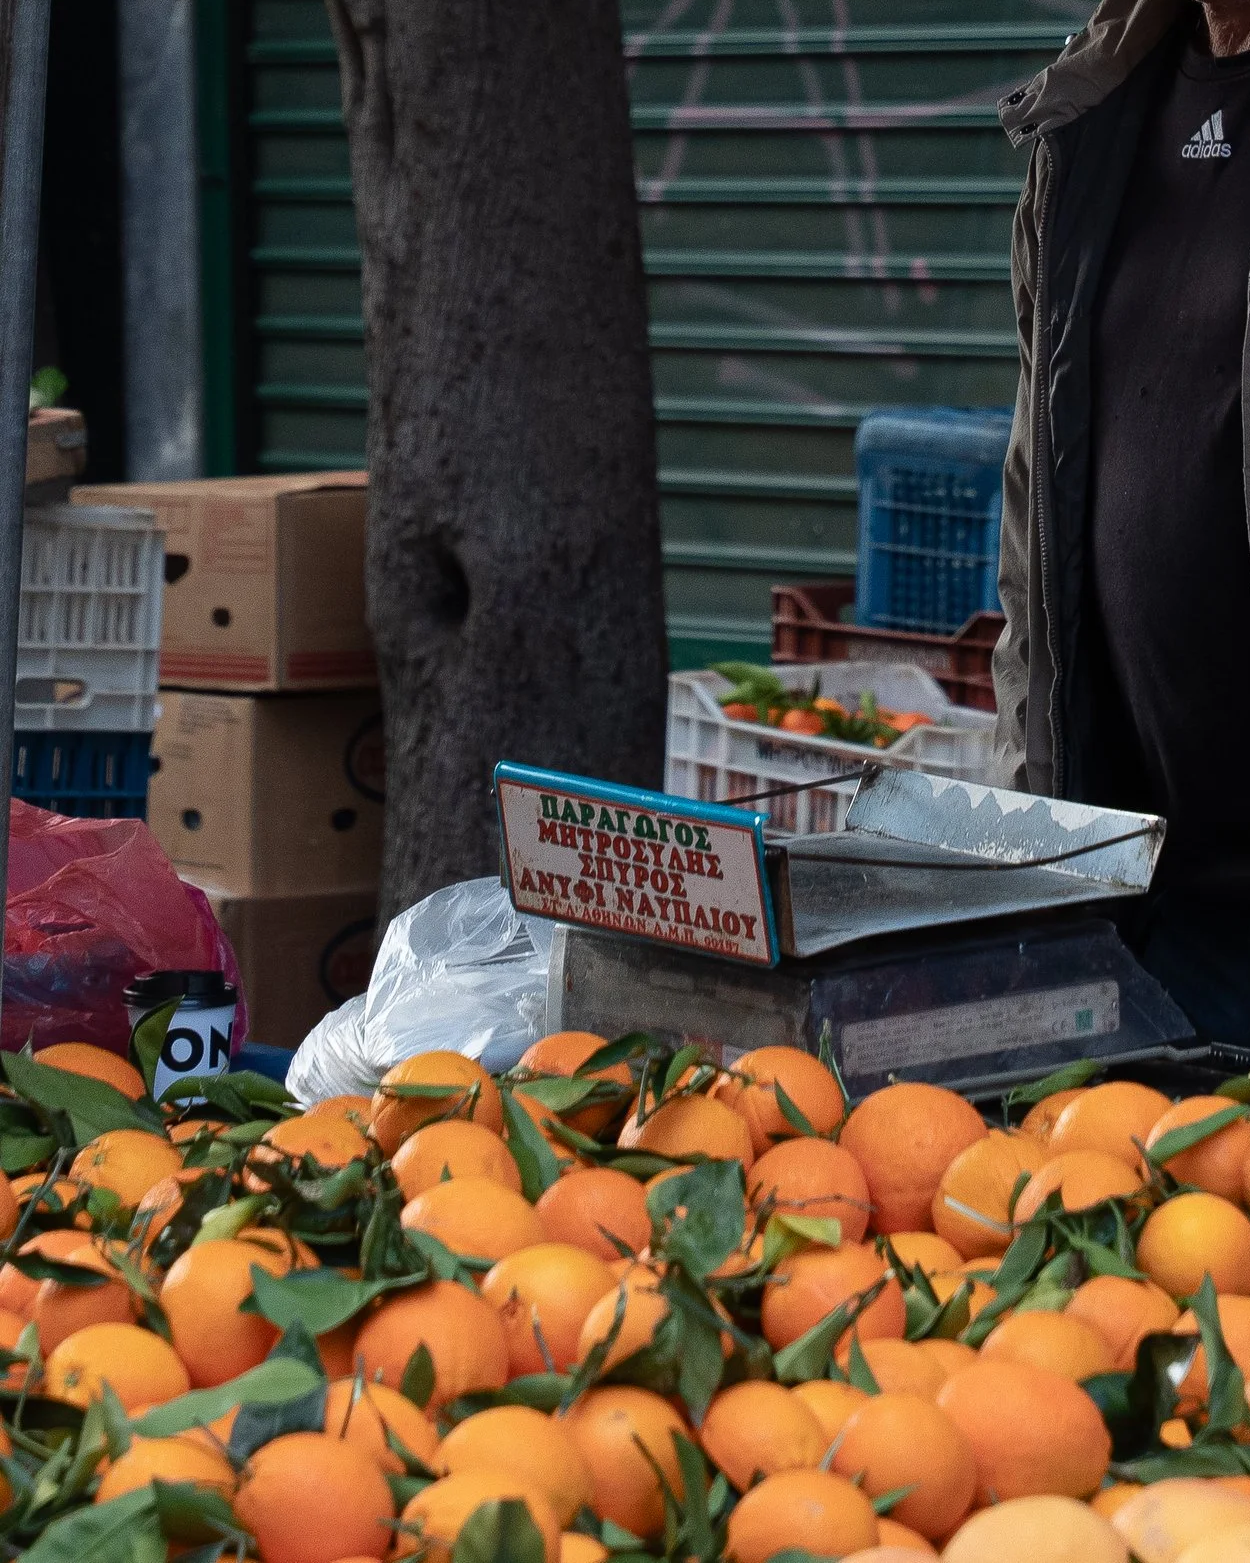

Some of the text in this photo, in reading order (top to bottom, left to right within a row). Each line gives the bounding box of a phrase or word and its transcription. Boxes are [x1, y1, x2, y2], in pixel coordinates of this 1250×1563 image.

[1181, 139, 1232, 159] adidas
[539, 793, 712, 852] ΠΑΡΑΓΩΓΟΣ
[536, 818, 725, 881] ΜΗΤΡΟΣΥΛΗΣ
[577, 851, 688, 899] ΣΠΥΡΟΣ
[518, 866, 758, 941] ΑΝΥΦΙ ΝΑΥΠΛΙΟΥ
[581, 906, 647, 933] ΑΘΗΝΩΝ
